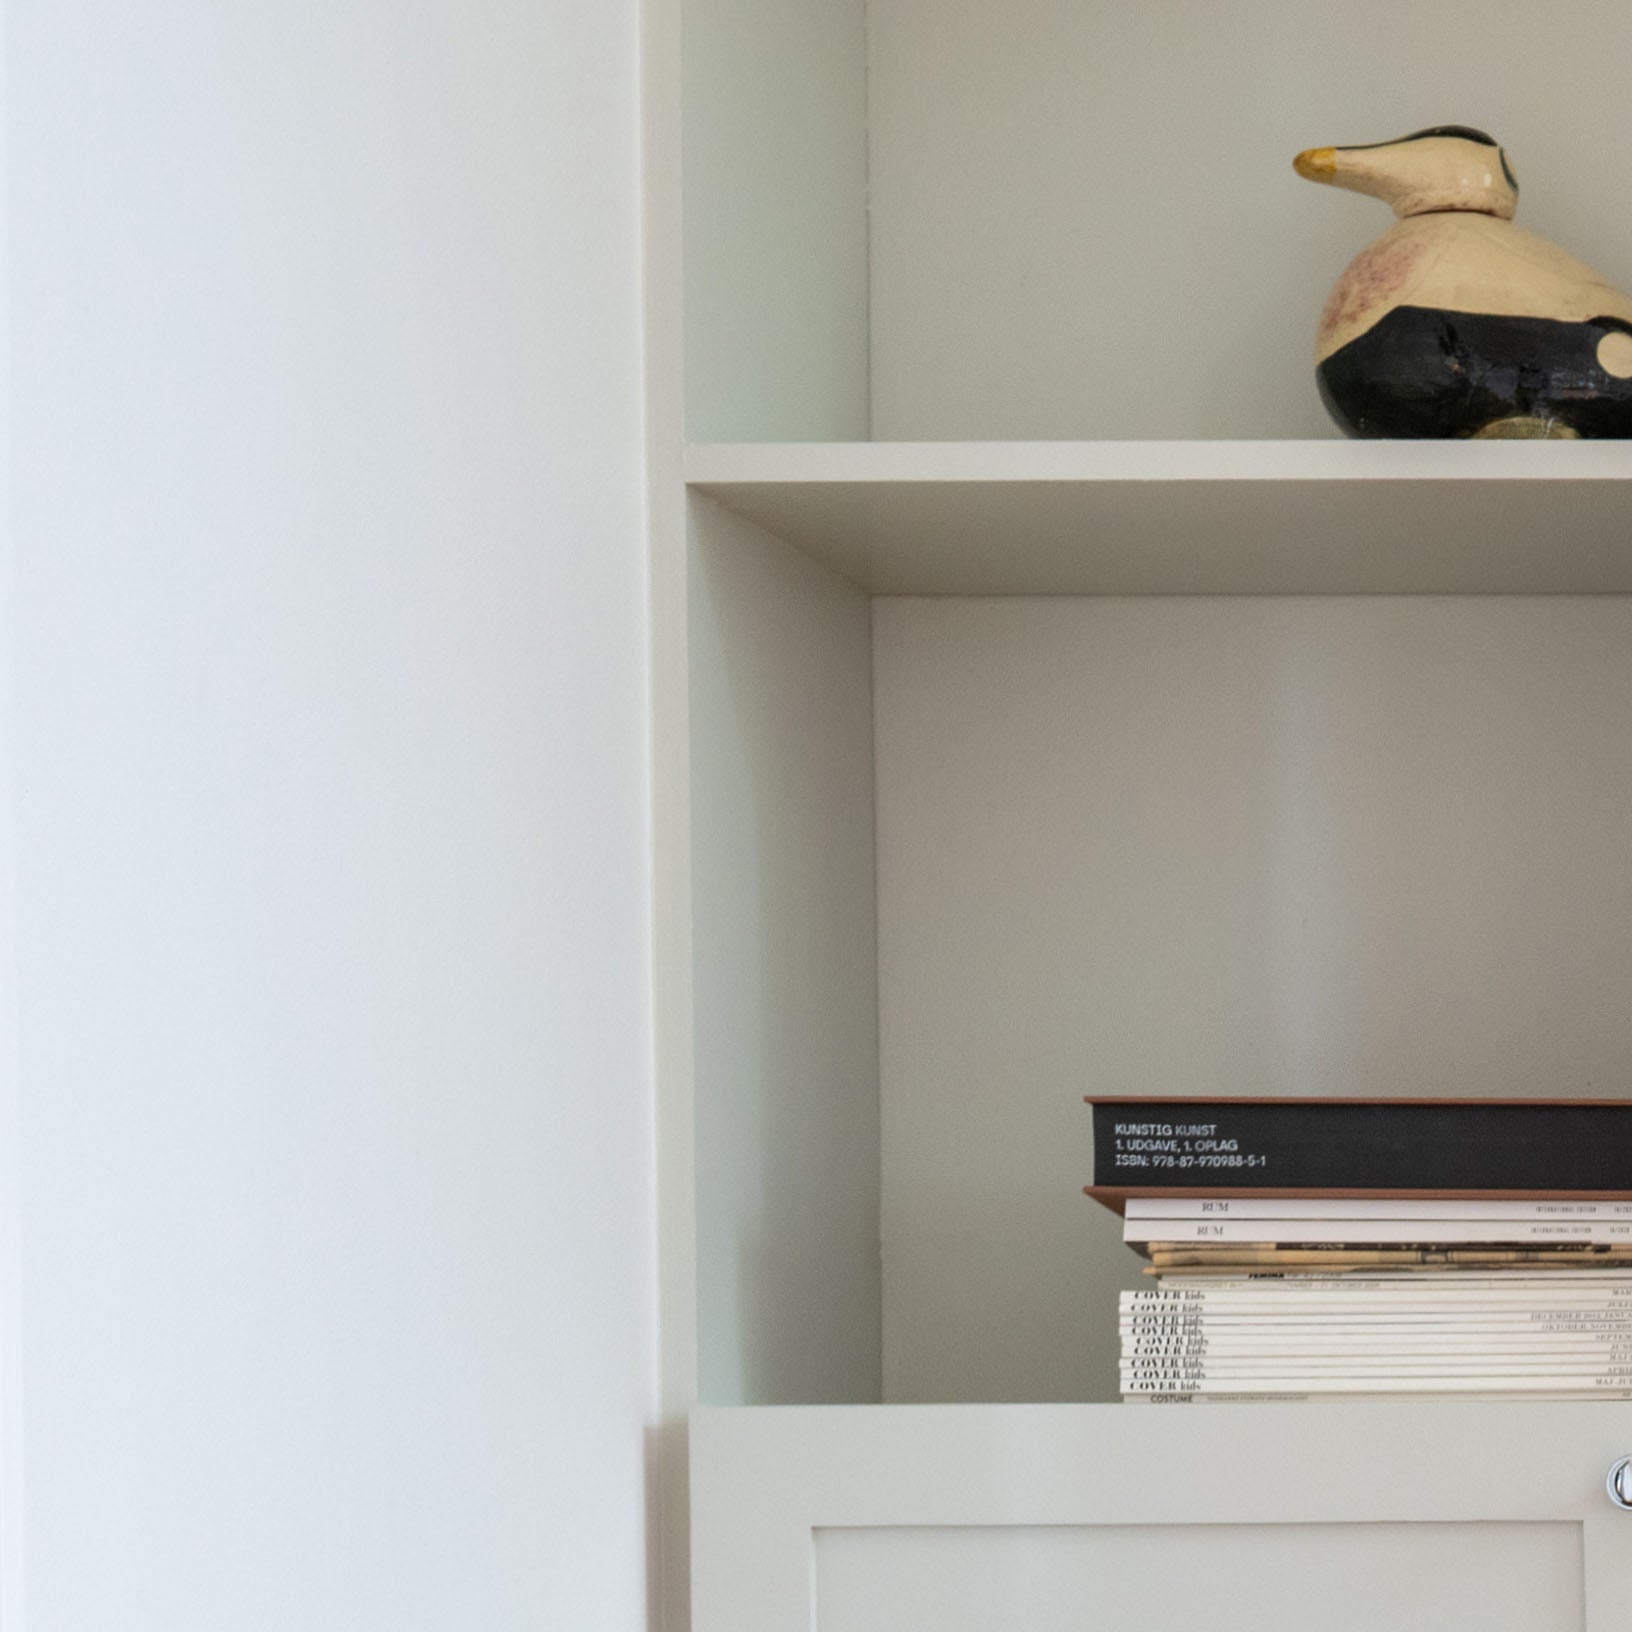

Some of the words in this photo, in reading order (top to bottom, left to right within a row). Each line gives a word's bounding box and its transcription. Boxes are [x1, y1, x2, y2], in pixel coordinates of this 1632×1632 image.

[1115, 1124, 1172, 1135] KUNSTIG
[1176, 1125, 1216, 1135] KUNST
[1127, 1140, 1181, 1152] UDGAVE,
[1196, 1140, 1238, 1151] OPLAG
[1115, 1155, 1149, 1166] ISBN:
[1153, 1155, 1265, 1167] 978-87-970988-5-1
[1130, 1382, 1177, 1390] COVER
[1181, 1382, 1200, 1391] kids
[1151, 1395, 1192, 1403] COSTUME
